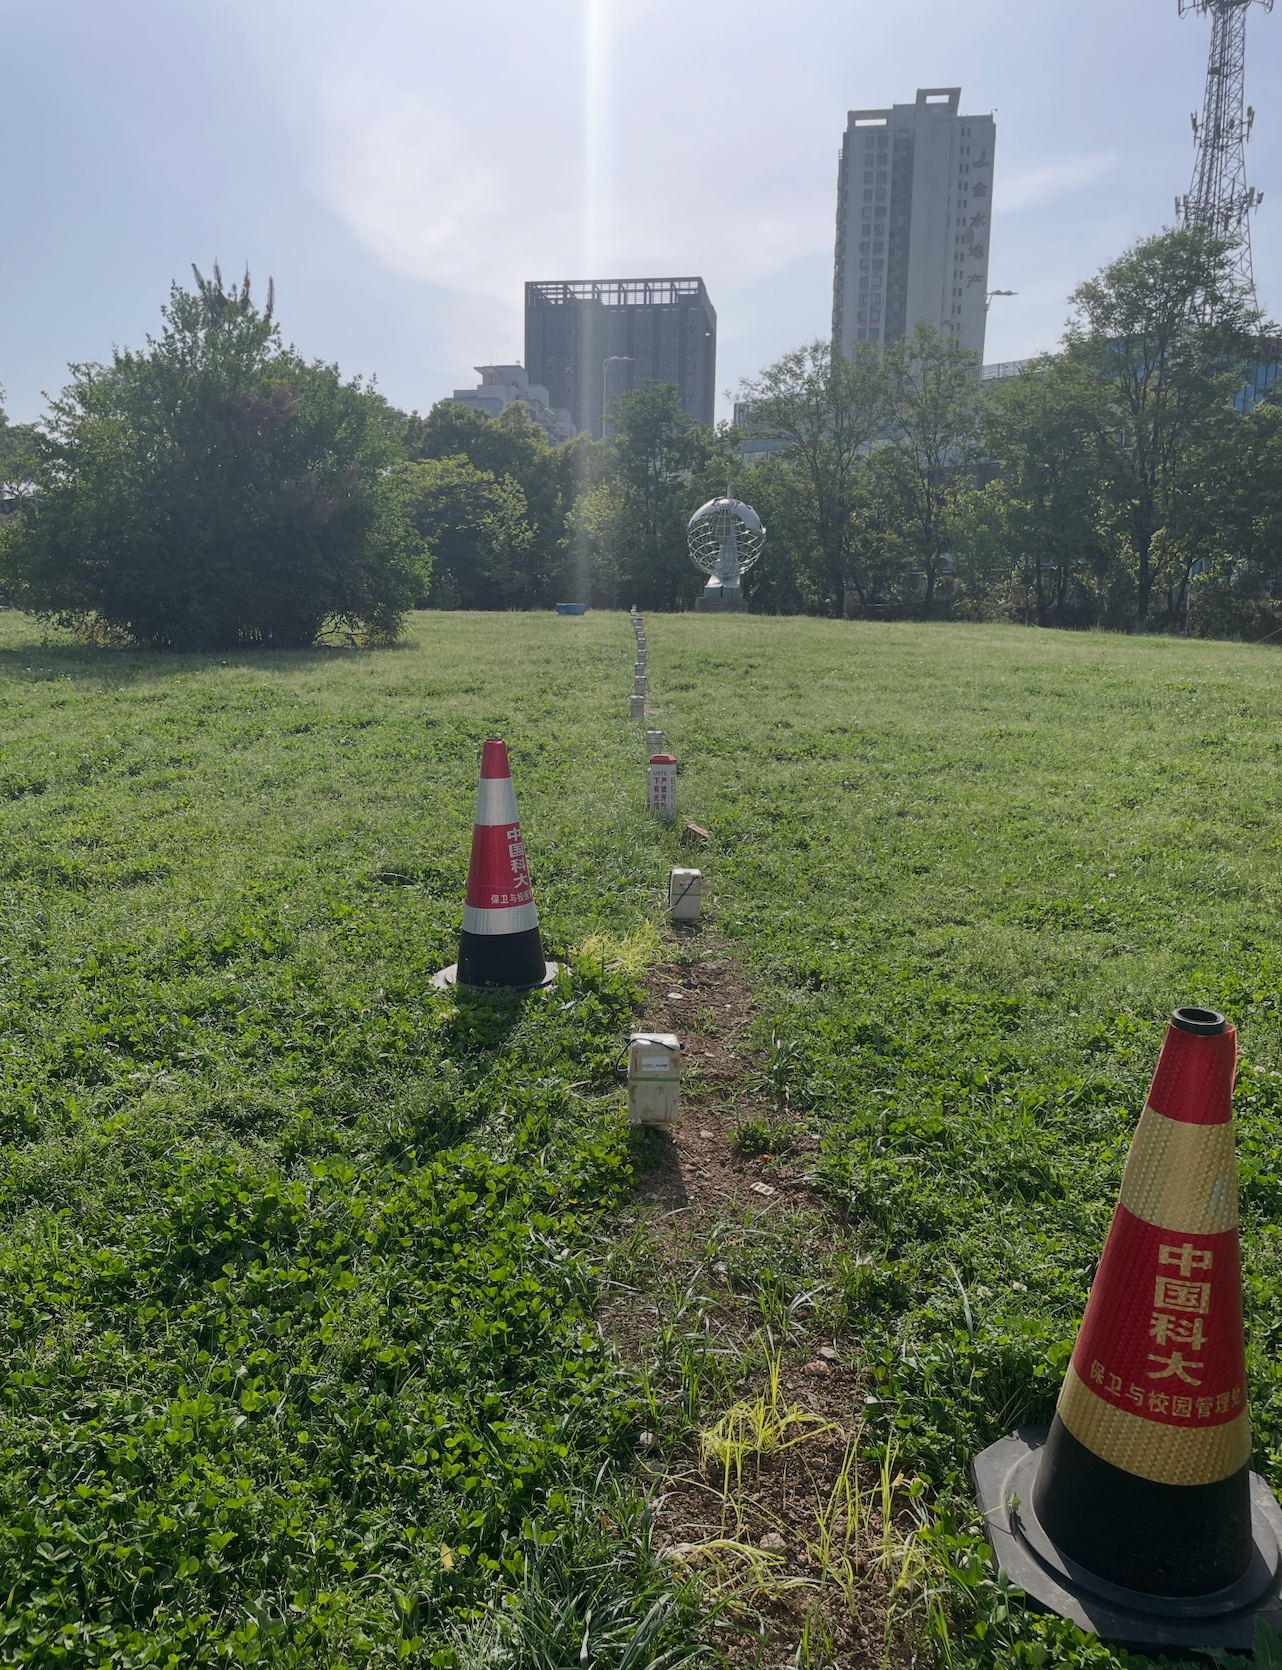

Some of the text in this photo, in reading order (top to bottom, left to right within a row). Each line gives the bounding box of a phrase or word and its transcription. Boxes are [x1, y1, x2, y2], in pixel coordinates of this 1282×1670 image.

[965, 181, 988, 289] 金水地产
[506, 826, 529, 889] 中国科大
[1145, 1242, 1214, 1387] 中国科大
[1089, 1358, 1241, 1419] 保卫与校园管理处
